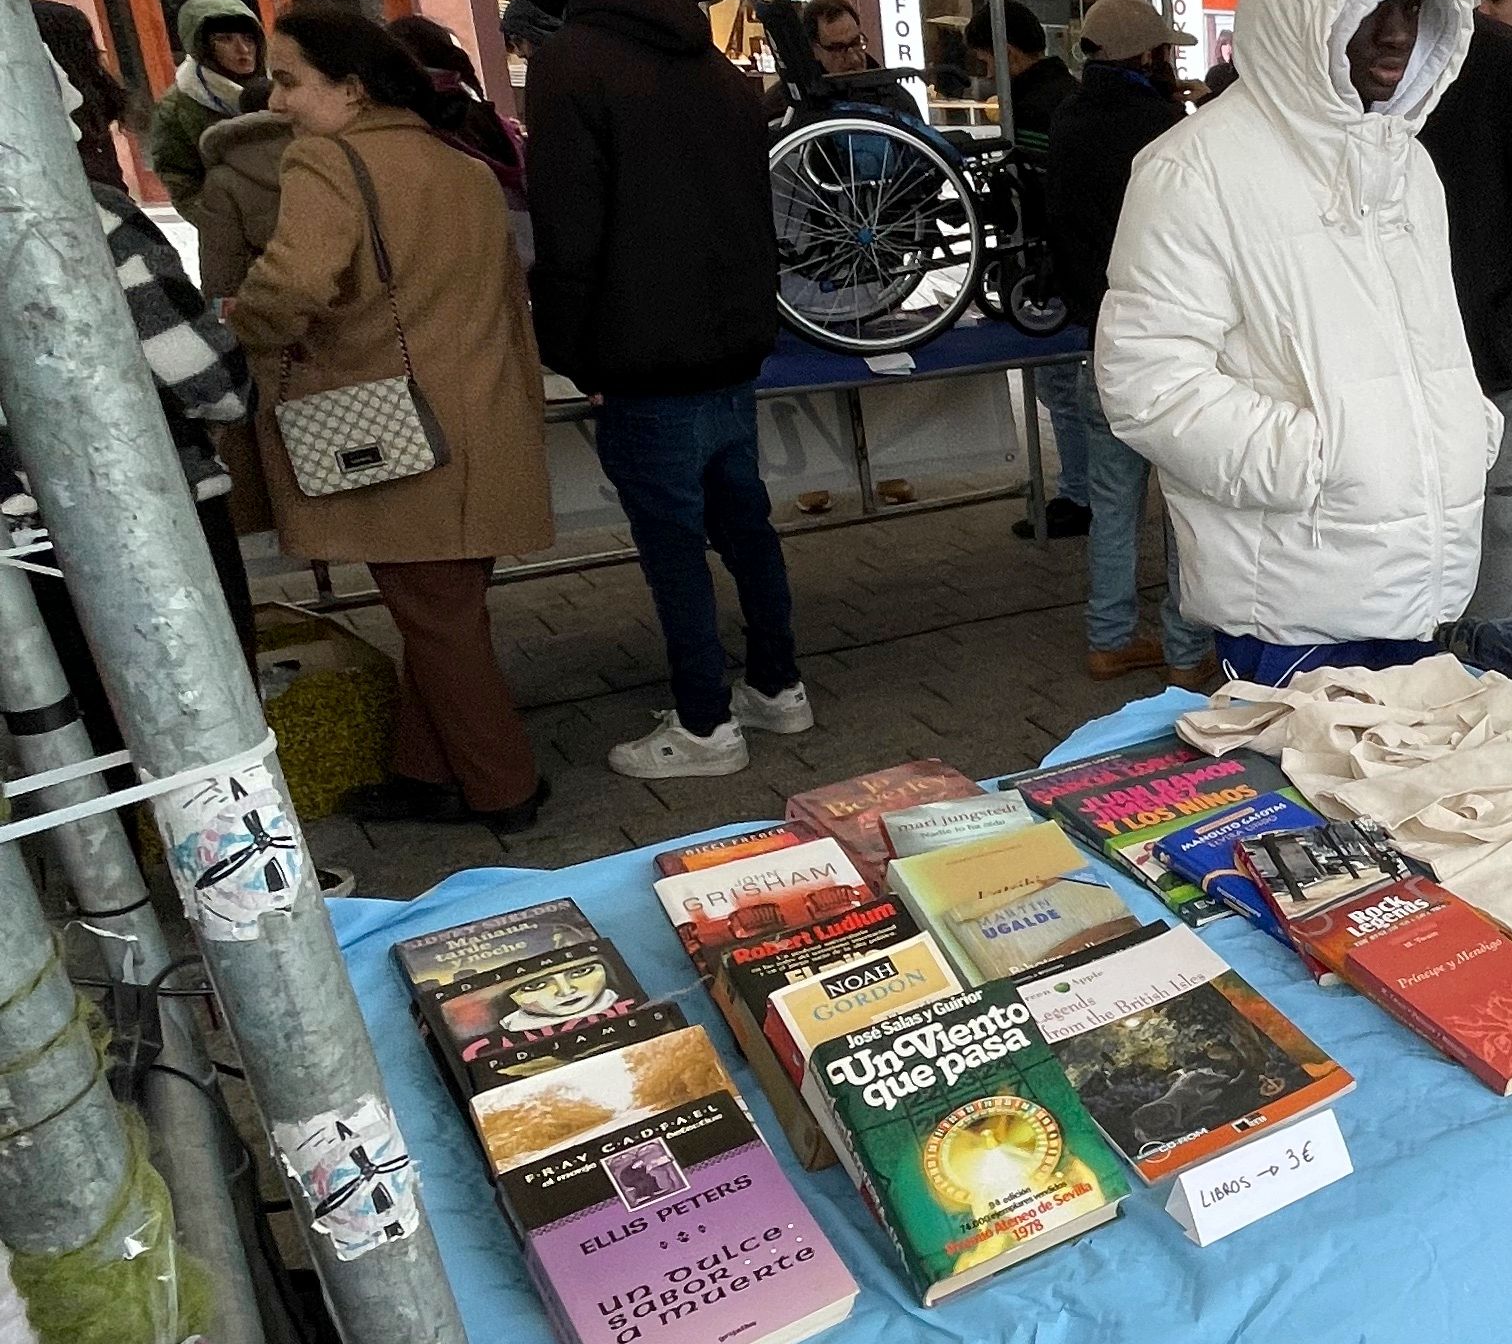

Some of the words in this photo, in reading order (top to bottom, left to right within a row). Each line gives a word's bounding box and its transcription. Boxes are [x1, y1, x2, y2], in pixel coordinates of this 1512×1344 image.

[897, 815, 938, 834] mari
[939, 803, 1018, 828] jungstedt
[1097, 820, 1121, 835] Y
[1121, 808, 1177, 830] LOS
[1181, 822, 1241, 851] MANOLITO
[682, 862, 838, 912] GRISHAM
[734, 869, 779, 888] JOHN
[732, 931, 813, 965] Robert
[813, 903, 897, 942] Ludlum
[981, 908, 1061, 939] UGALDE
[434, 941, 492, 963] tarde
[467, 941, 527, 963] noche
[1446, 959, 1456, 971] y
[1456, 938, 1503, 965] Mendigo
[812, 967, 926, 1022] GORDON
[825, 961, 898, 998] NOAH
[1025, 988, 1050, 1001] reen
[1089, 1006, 1116, 1027] the
[1113, 984, 1169, 1014] British
[1169, 972, 1207, 995] Isles
[848, 1025, 884, 1049] José
[883, 1011, 923, 1037] Salas
[922, 1008, 933, 1025] y
[933, 989, 984, 1018] Guirior
[826, 1047, 905, 1086] Un
[892, 1002, 1031, 1059] Viento
[862, 1062, 937, 1111] que
[936, 1028, 1032, 1087] pasa
[994, 1209, 1037, 1235] Ateneo
[1038, 1200, 1055, 1214] de
[1052, 1180, 1094, 1206] Sevilla
[1200, 1175, 1252, 1208] LIBROS
[579, 1217, 650, 1256] ELLIS
[656, 1173, 754, 1223] PETERS
[1012, 1218, 1044, 1242] 1978
